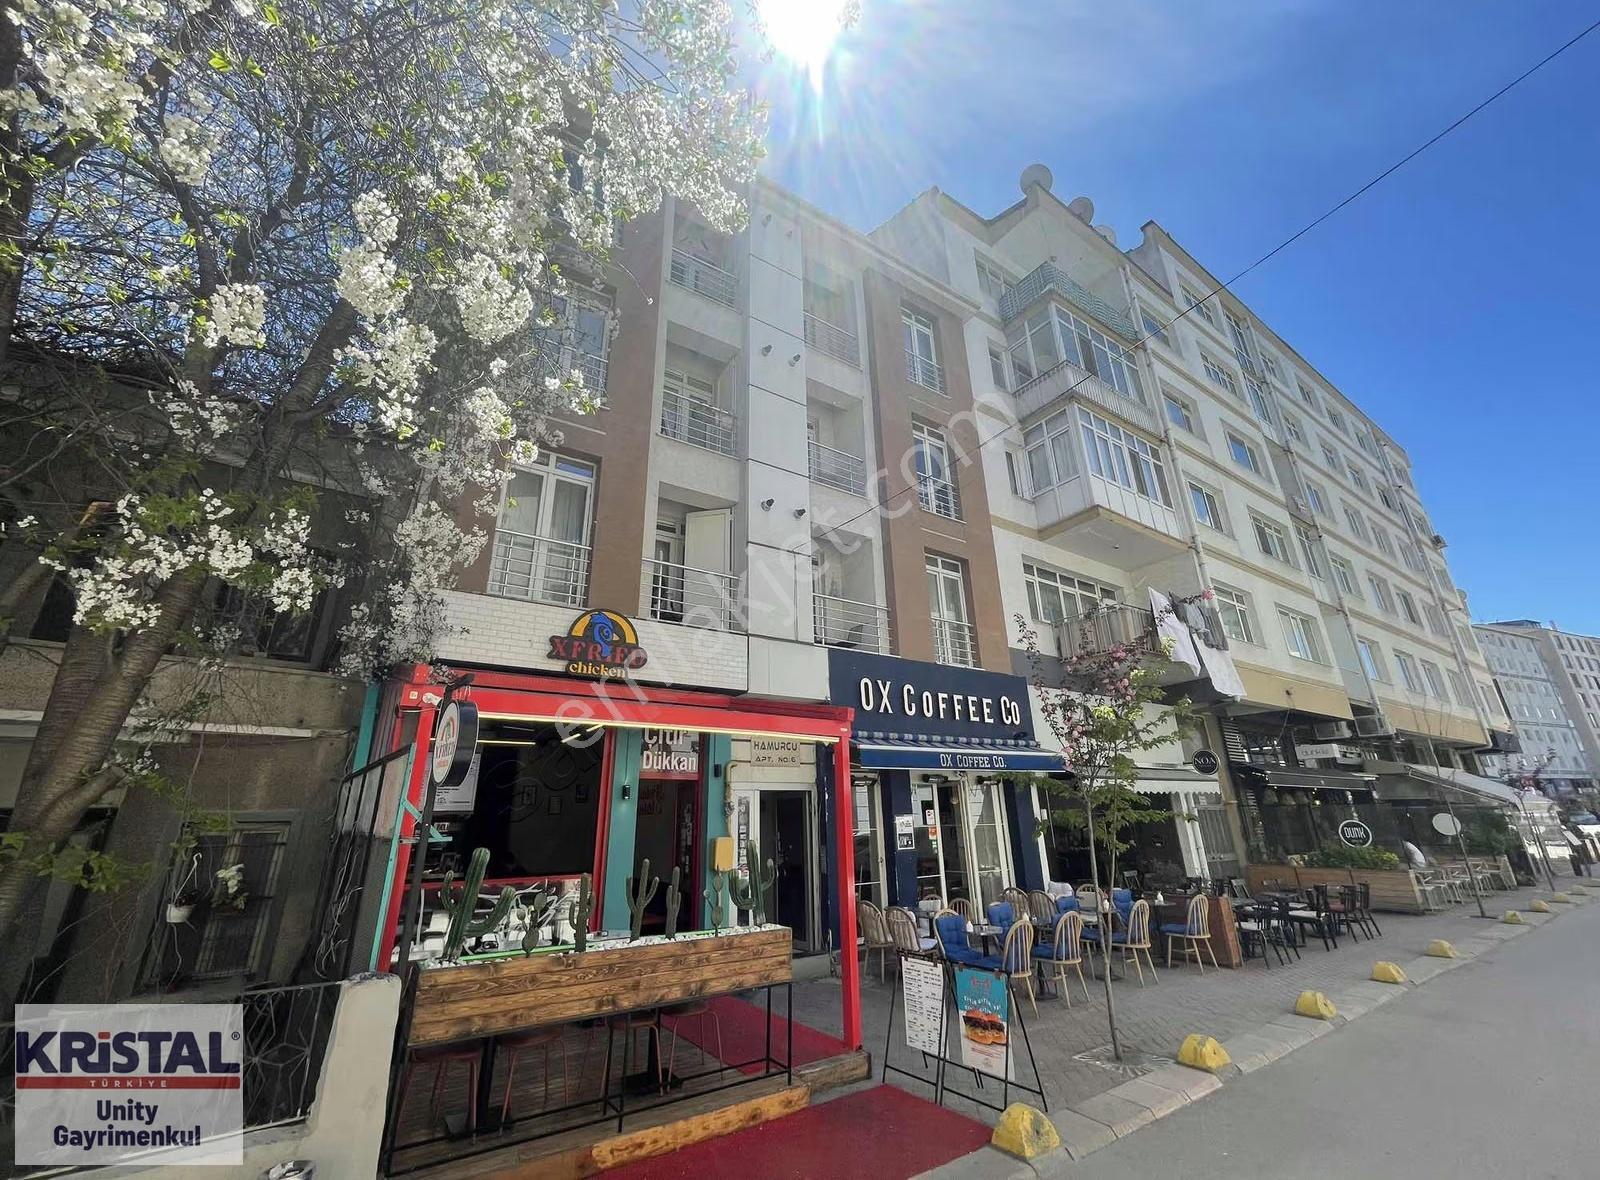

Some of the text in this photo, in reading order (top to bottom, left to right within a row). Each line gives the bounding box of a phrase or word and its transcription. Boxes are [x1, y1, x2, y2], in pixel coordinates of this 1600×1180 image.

[569, 661, 626, 678] chicken
[860, 677, 893, 714] OX
[903, 683, 994, 724] COFFEE
[753, 741, 798, 751] HAMURCU
[642, 750, 697, 771] Dükkan
[940, 753, 953, 767] OX
[956, 754, 991, 768] COFFEE
